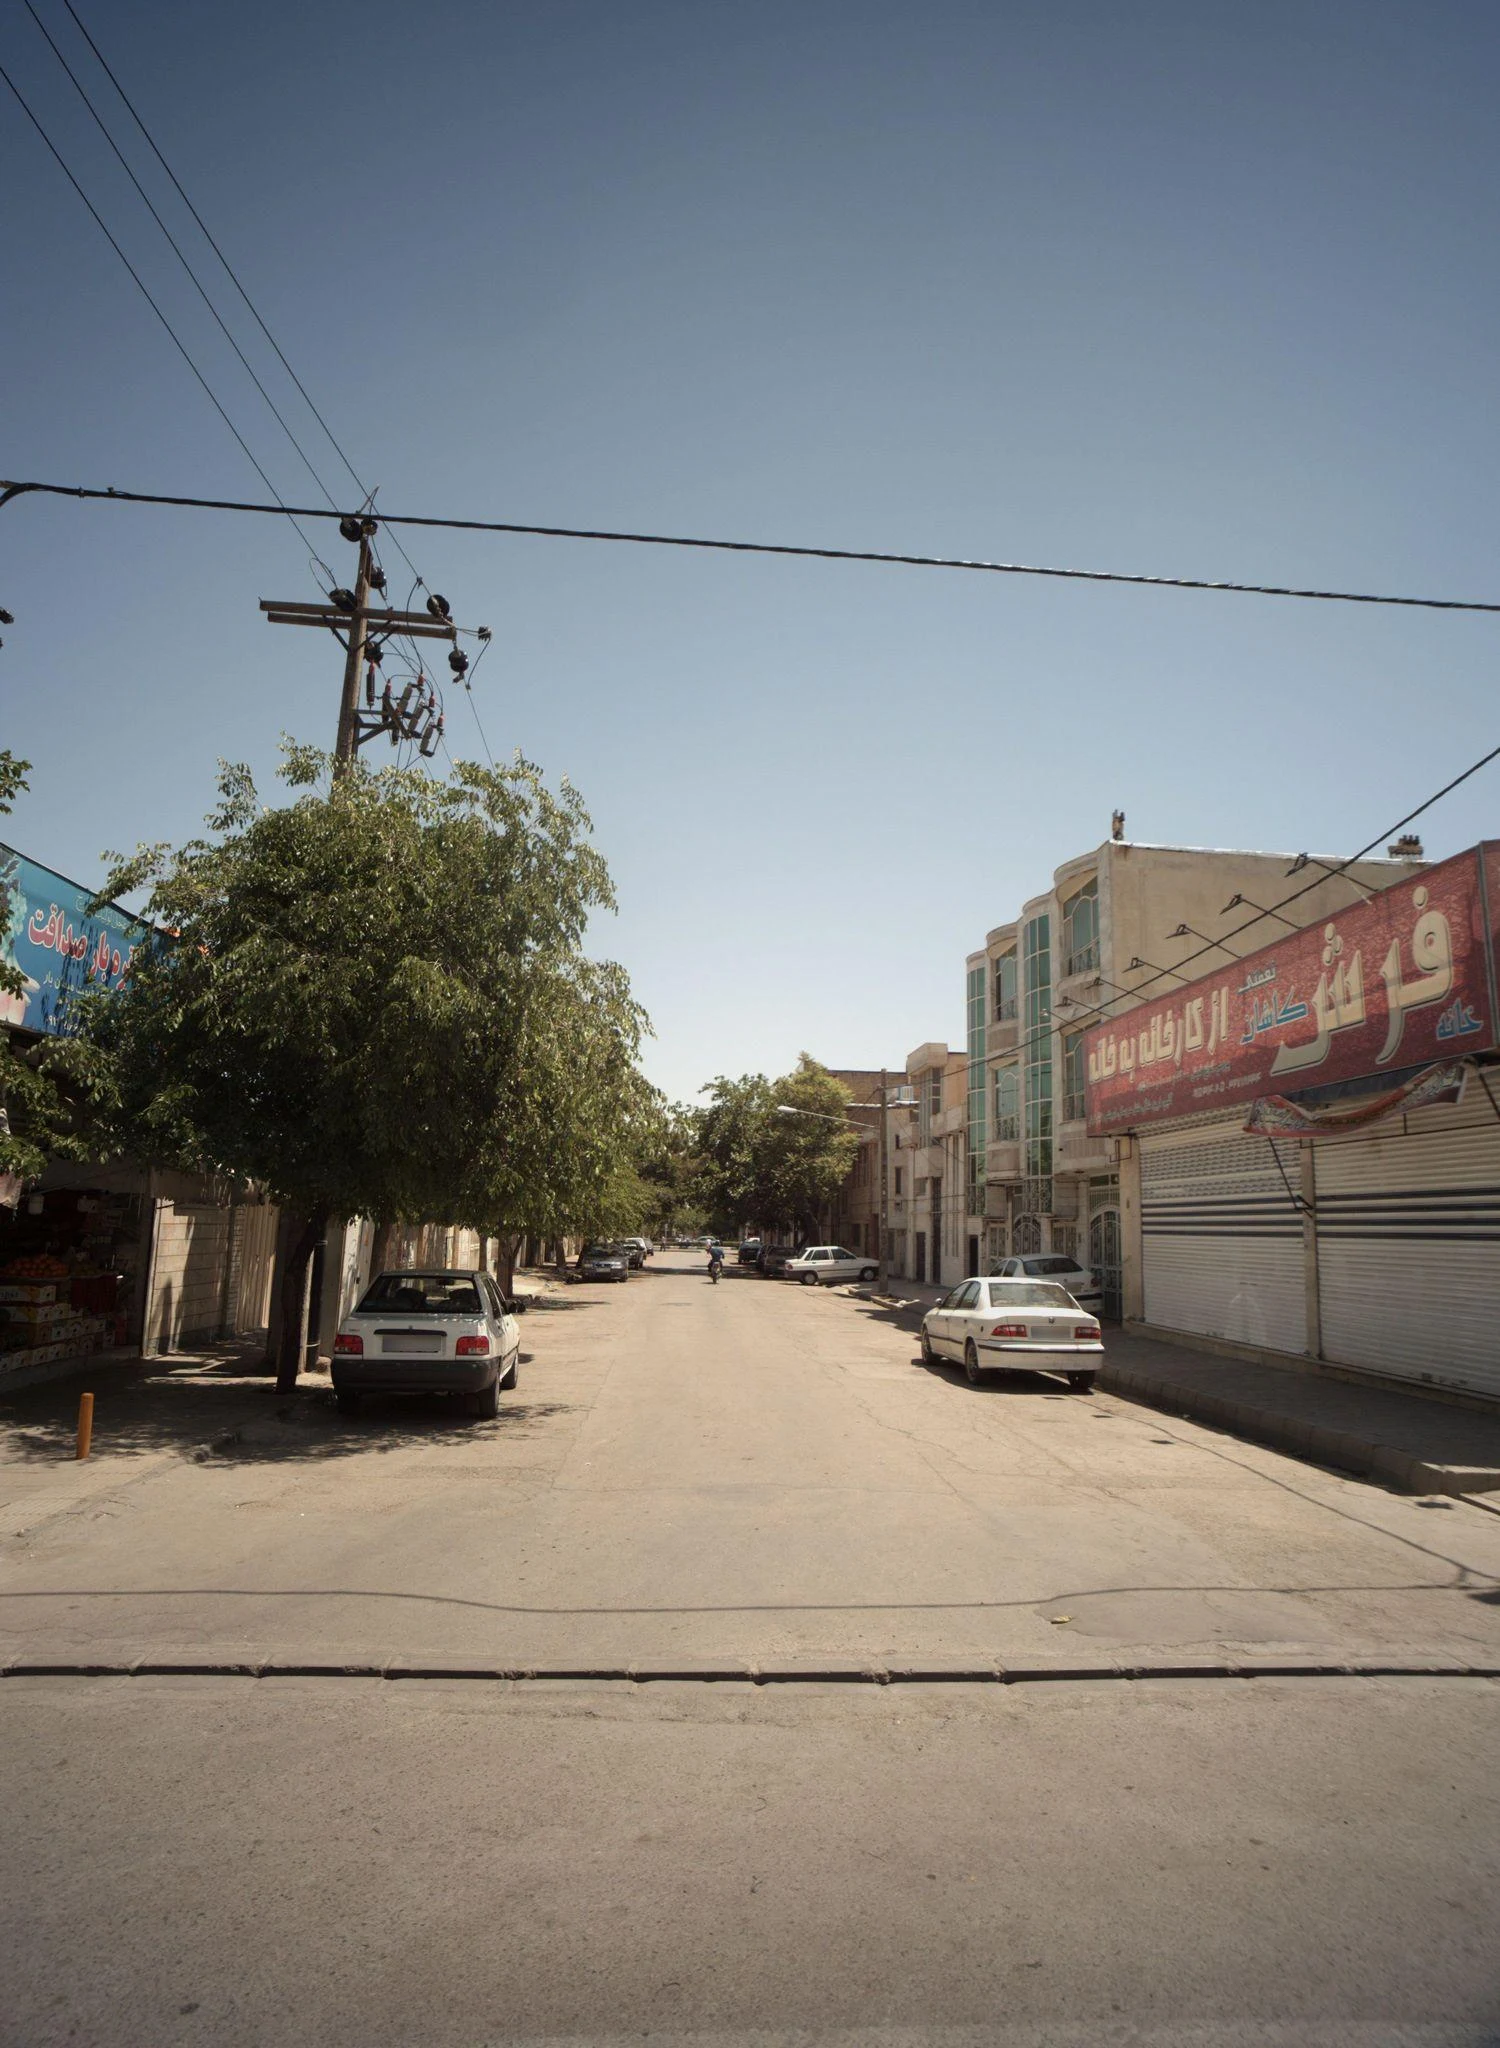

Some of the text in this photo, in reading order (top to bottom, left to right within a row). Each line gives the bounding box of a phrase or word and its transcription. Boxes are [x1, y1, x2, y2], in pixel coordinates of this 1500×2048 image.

[28, 903, 87, 961] صداقت
[1270, 886, 1453, 1077] فرش
[1140, 997, 1204, 1068] کارخانه
[1208, 986, 1229, 1056] از
[1240, 985, 1309, 1045] کاشان
[1437, 998, 1484, 1040] خانه
[1089, 1033, 1118, 1085] خانه
[1119, 1035, 1136, 1084] به
